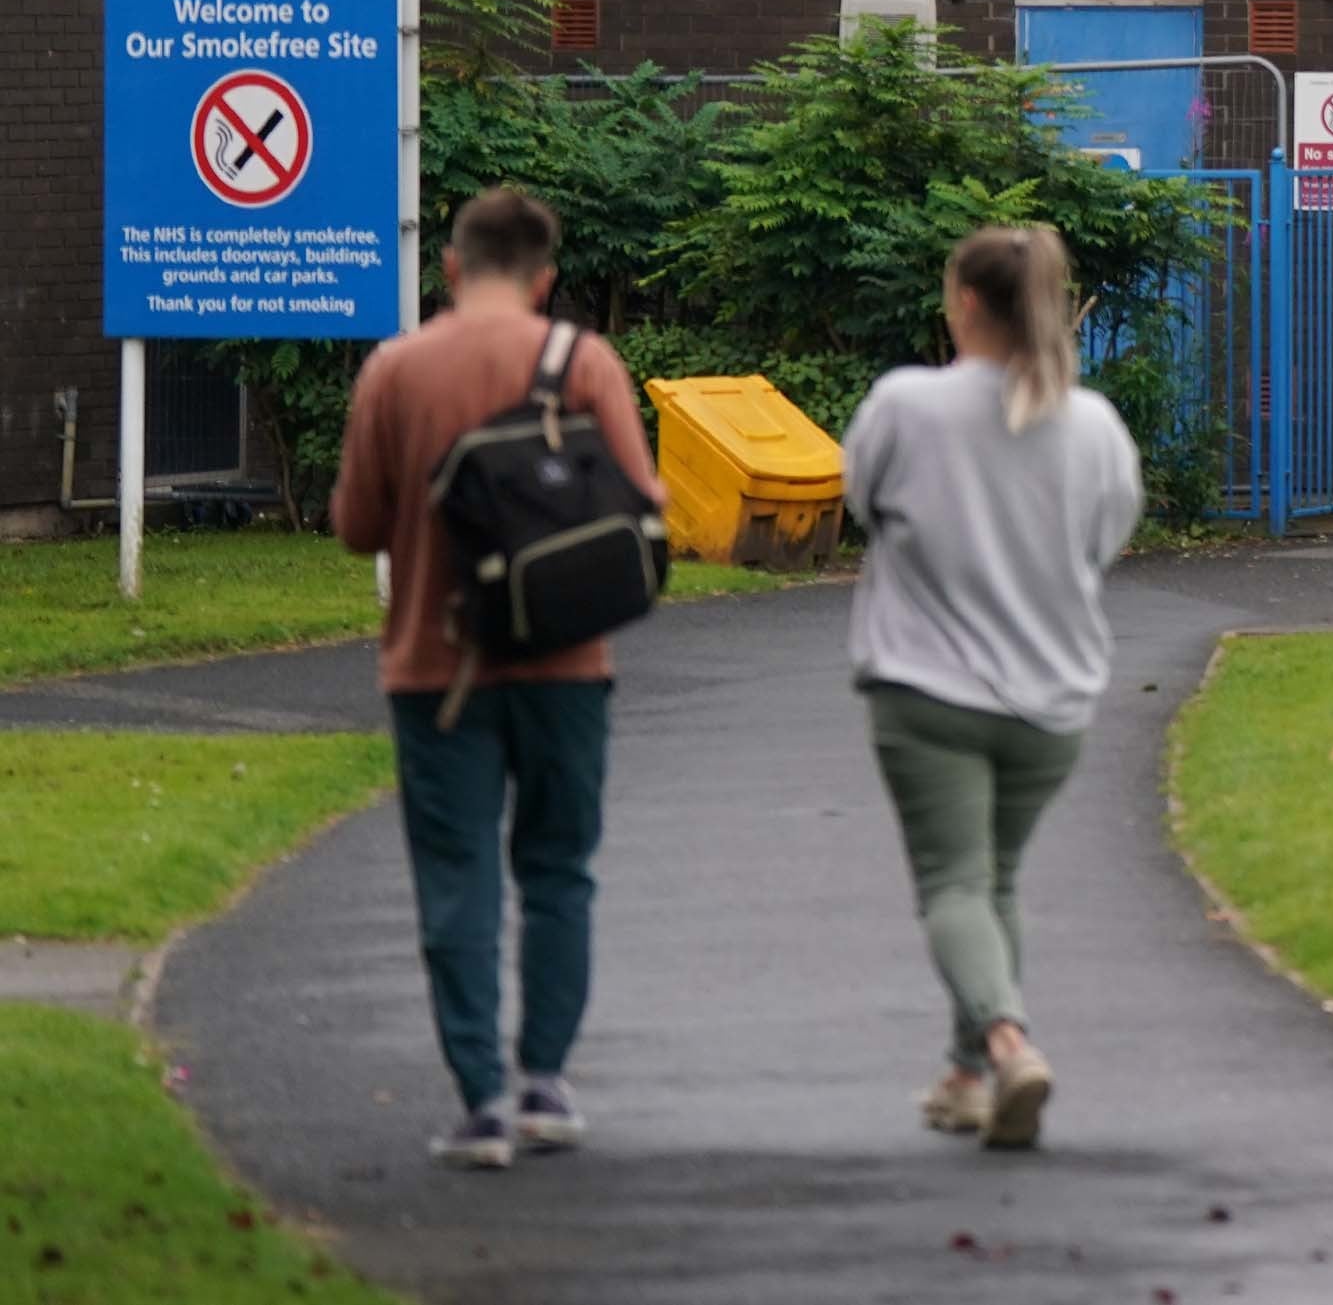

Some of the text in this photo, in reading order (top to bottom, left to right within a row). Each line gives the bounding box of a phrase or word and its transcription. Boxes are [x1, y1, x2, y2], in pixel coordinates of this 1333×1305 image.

[302, 0, 330, 25] to
[126, 31, 378, 58] Our Smokefree Site
[1304, 147, 1322, 161] No
[122, 227, 380, 248] The NHS is completely smokefree.
[121, 247, 382, 268] This includes doorways, buildings,
[162, 268, 339, 289] grounds and car parks.
[147, 296, 355, 317] Thank you for not smoking
